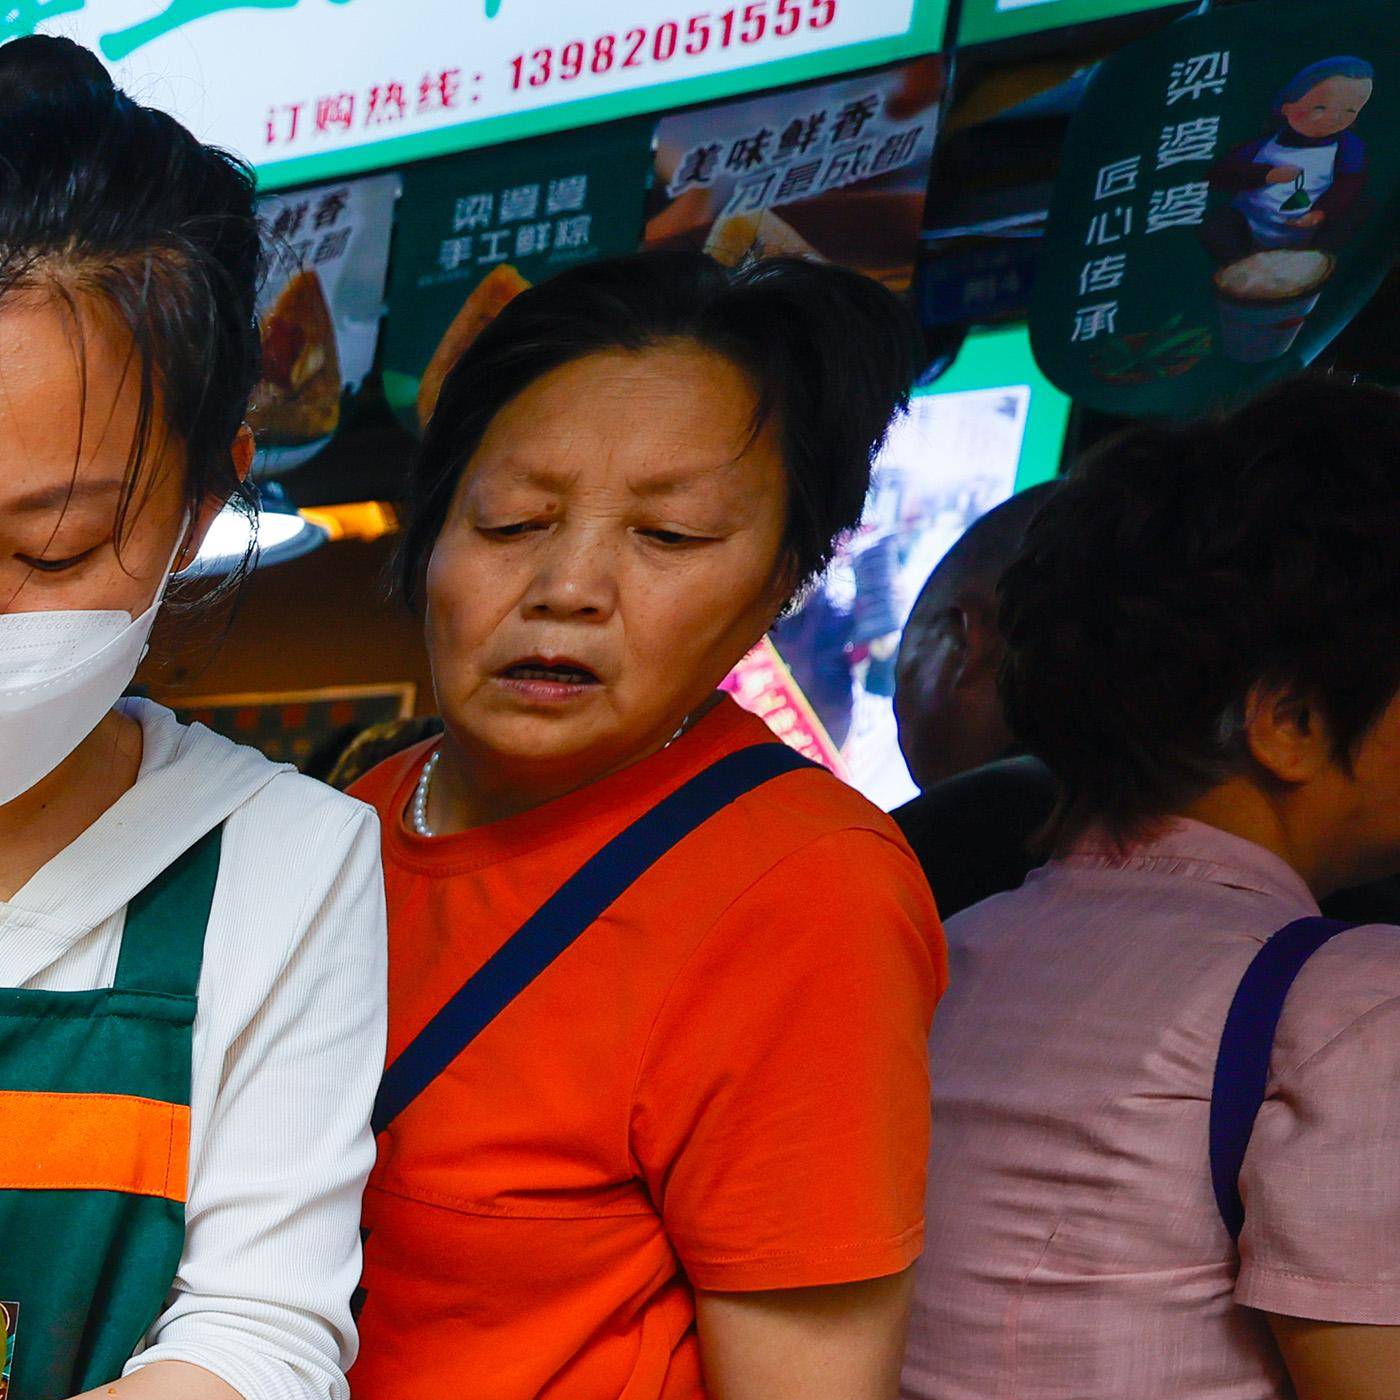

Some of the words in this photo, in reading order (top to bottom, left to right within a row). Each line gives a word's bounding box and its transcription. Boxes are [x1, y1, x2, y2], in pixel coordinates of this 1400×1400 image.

[509, 0, 837, 91] 13982051555
[671, 92, 881, 192] 美味鲜香
[1146, 51, 1230, 234] 梁婆婆
[437, 213, 593, 271] 手工鲜粽
[1071, 156, 1141, 342] 匠心传承
